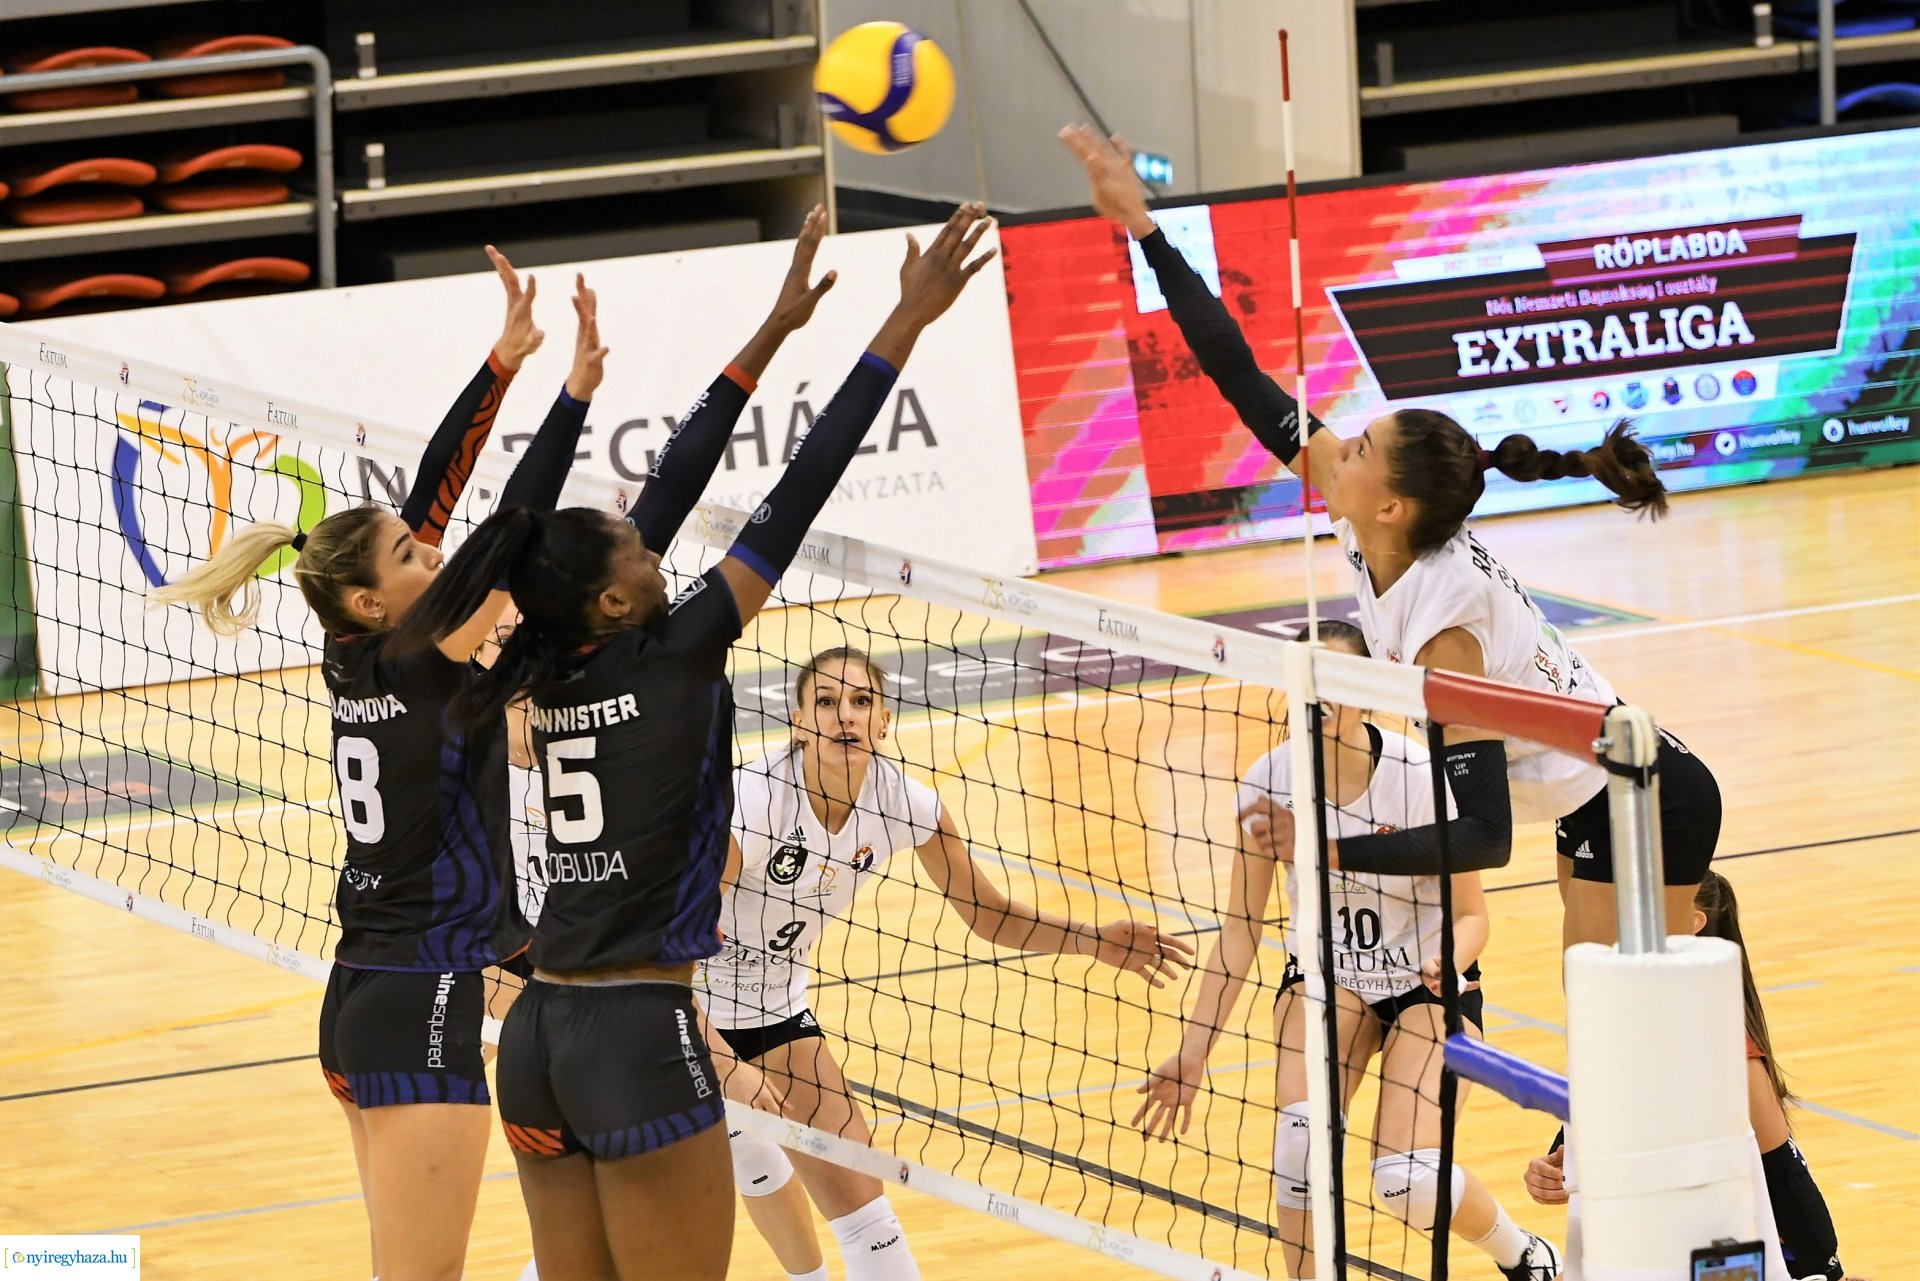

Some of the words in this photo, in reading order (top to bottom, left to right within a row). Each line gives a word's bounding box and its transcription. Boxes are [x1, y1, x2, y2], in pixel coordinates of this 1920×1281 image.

[1592, 228, 1747, 270] RÖPLABDA
[1452, 300, 1755, 378] EXTRALIGA
[267, 401, 299, 429] FATUM
[800, 543, 831, 564] ATUM
[1098, 608, 1140, 641] FATUM
[337, 735, 385, 844] 8
[546, 736, 604, 844] 5
[783, 846, 800, 855] CEV
[191, 917, 216, 942] FATUM
[768, 920, 807, 952] 9
[1337, 906, 1381, 951] 10
[1334, 946, 1413, 974] TUM
[1335, 972, 1412, 991] ÍREGYHÁZA
[426, 971, 456, 1069] ninesquared
[987, 1192, 1020, 1222] FATUM
